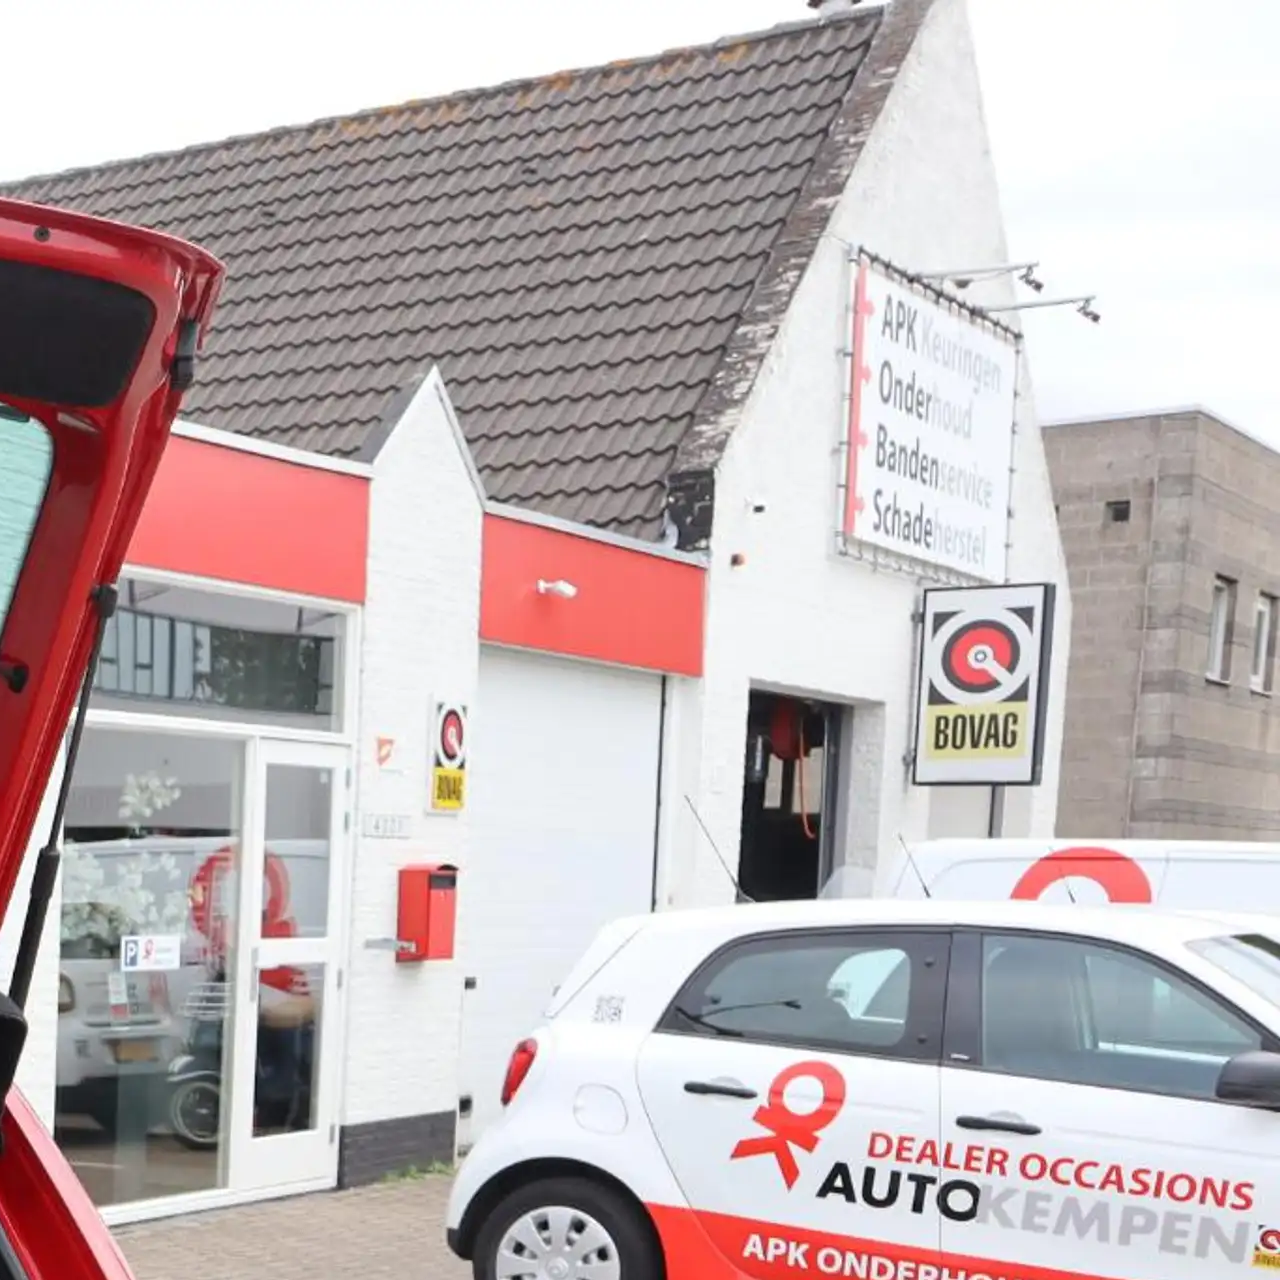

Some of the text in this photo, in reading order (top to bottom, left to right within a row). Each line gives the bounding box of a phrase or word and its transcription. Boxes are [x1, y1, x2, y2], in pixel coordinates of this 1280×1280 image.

[881, 294, 1002, 395] APK Keuringen
[879, 360, 974, 440] Onderhoud
[876, 424, 993, 508] Bandenservice
[873, 488, 987, 569] Schadeherstel
[934, 712, 1019, 750] BOVAG
[867, 1131, 1255, 1211] DEALER OCCASIONS
[742, 1234, 810, 1269] APK
[815, 1161, 1251, 1263] AUTOKEMPEN
